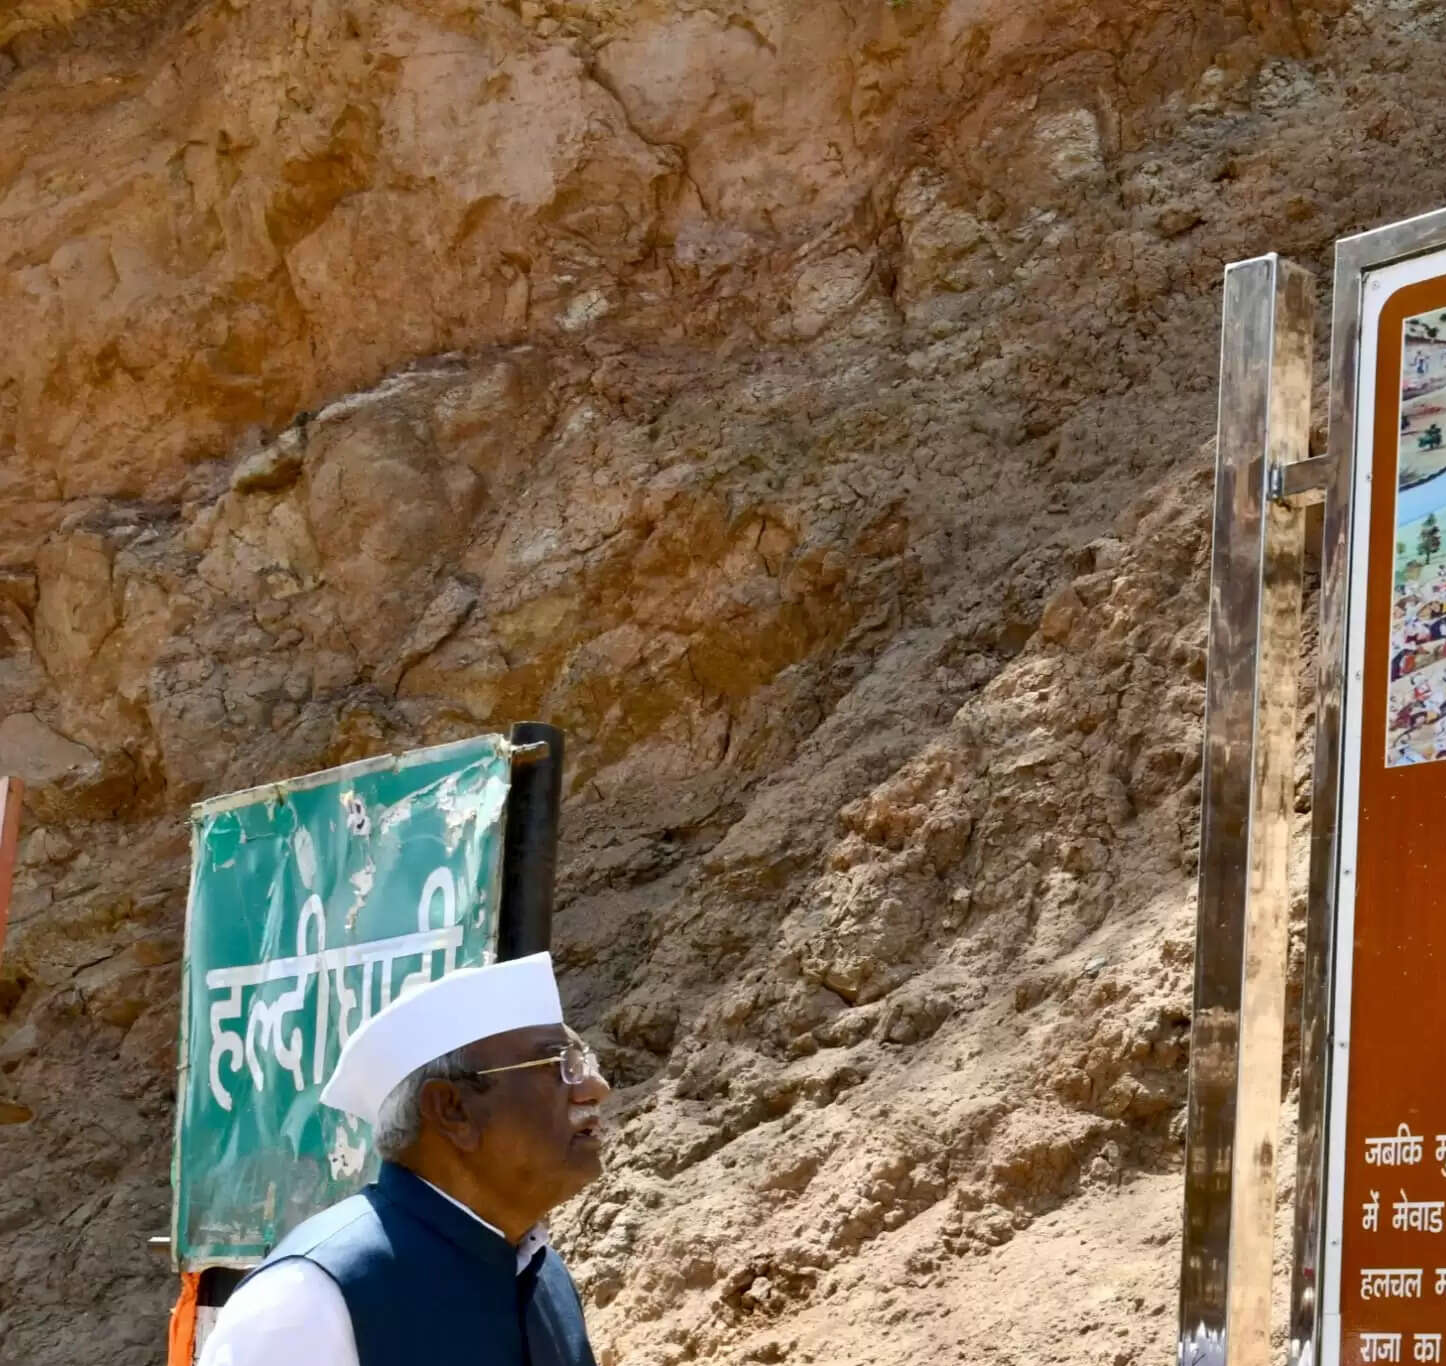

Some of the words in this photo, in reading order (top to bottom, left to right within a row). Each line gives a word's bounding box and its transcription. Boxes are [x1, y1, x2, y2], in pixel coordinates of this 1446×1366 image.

[1364, 1122, 1425, 1167] जबकि
[1359, 1268, 1424, 1300] हलचल
[1359, 1332, 1403, 1363] राजा
